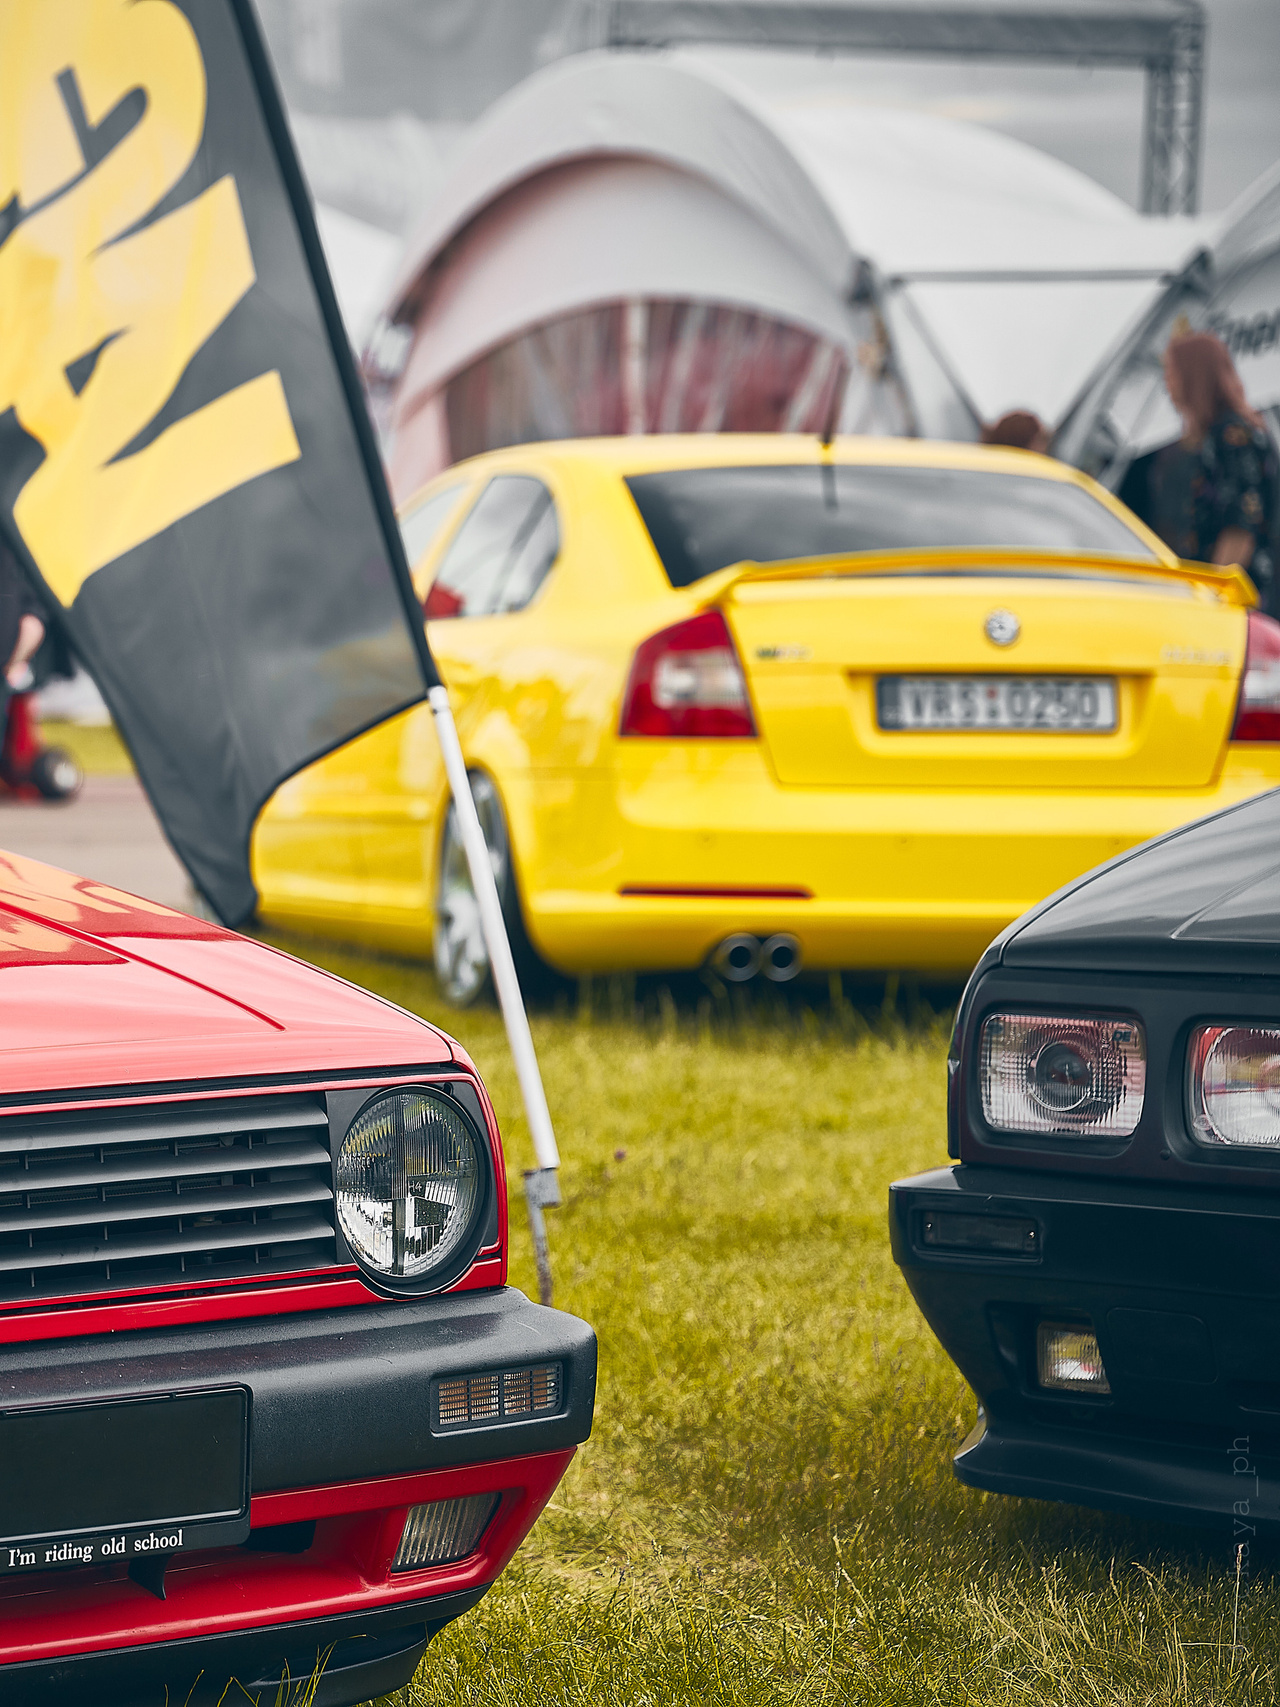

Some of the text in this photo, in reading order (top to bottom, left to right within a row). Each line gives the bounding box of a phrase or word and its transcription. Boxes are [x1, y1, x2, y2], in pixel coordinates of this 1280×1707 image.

[44, 1542, 94, 1563] riding
[101, 1535, 126, 1556] old
[134, 1528, 184, 1552] school
